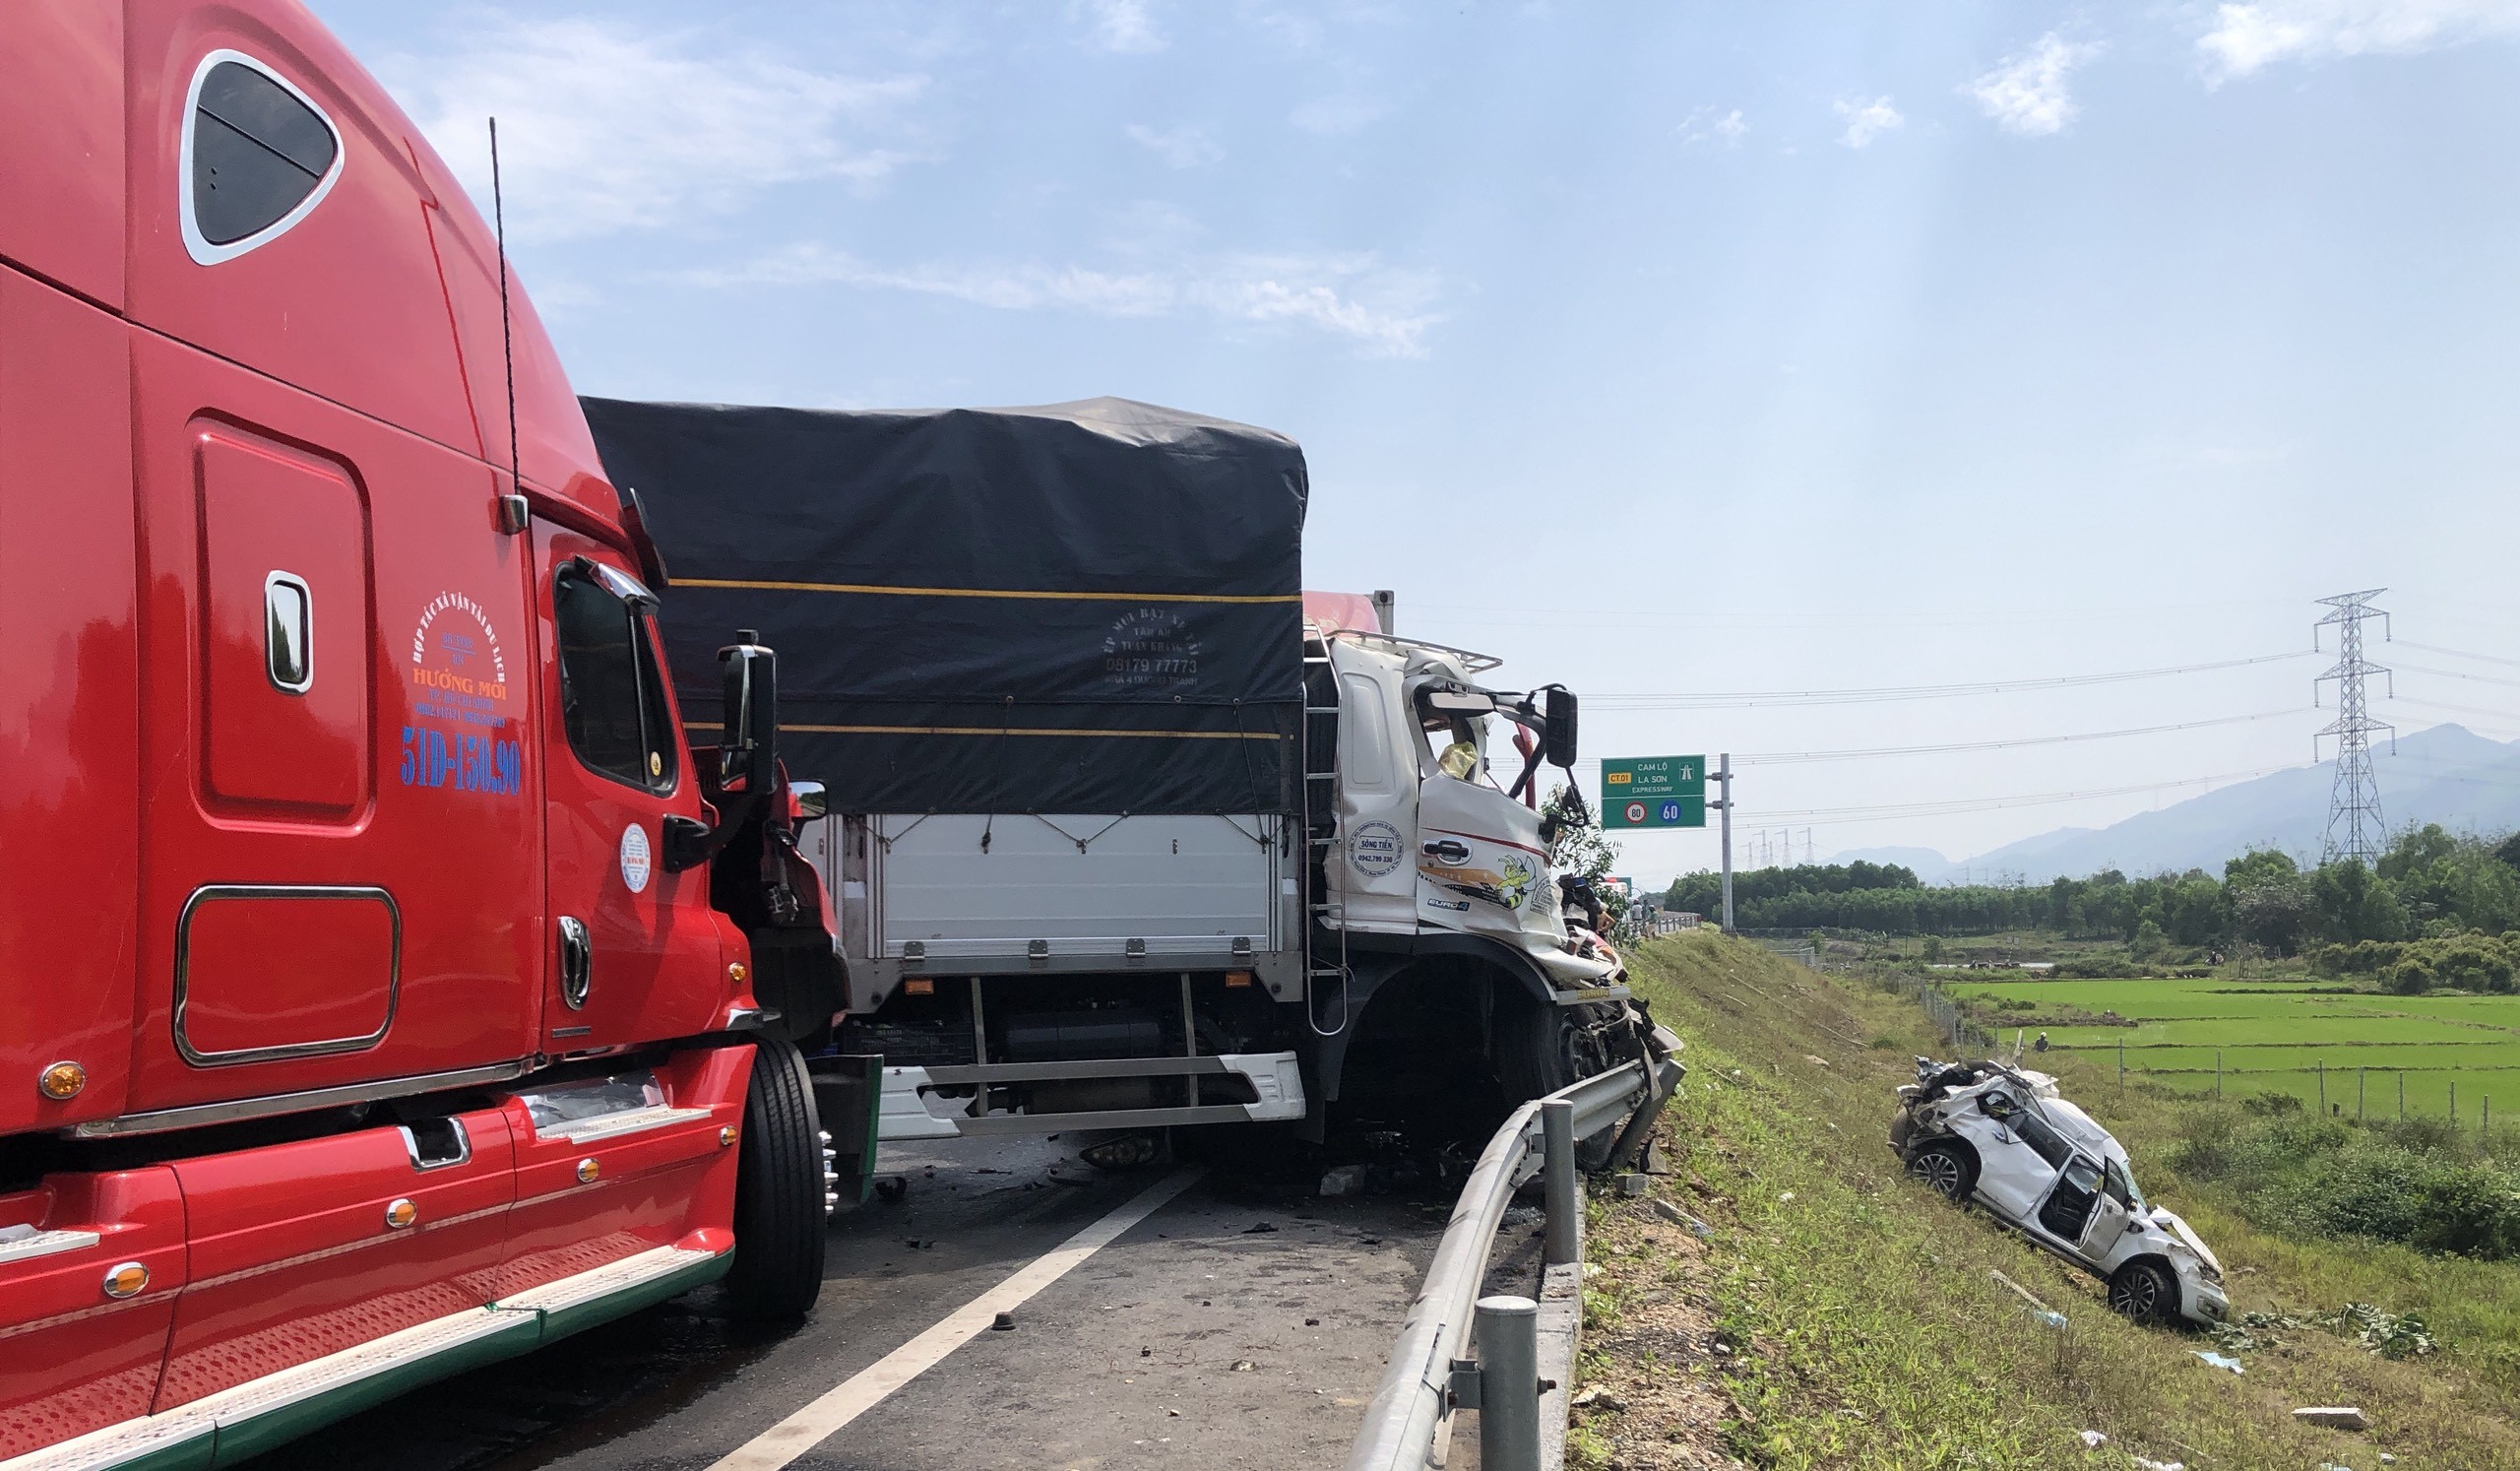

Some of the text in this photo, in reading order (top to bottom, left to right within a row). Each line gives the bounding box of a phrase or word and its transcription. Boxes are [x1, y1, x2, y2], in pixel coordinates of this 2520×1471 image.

[420, 606, 437, 630] TÁC
[1155, 659, 1198, 674] 77773
[413, 668, 508, 700] HƯỚNG MỚI
[1637, 763, 1656, 772] CAM
[1663, 804, 1678, 820] 60
